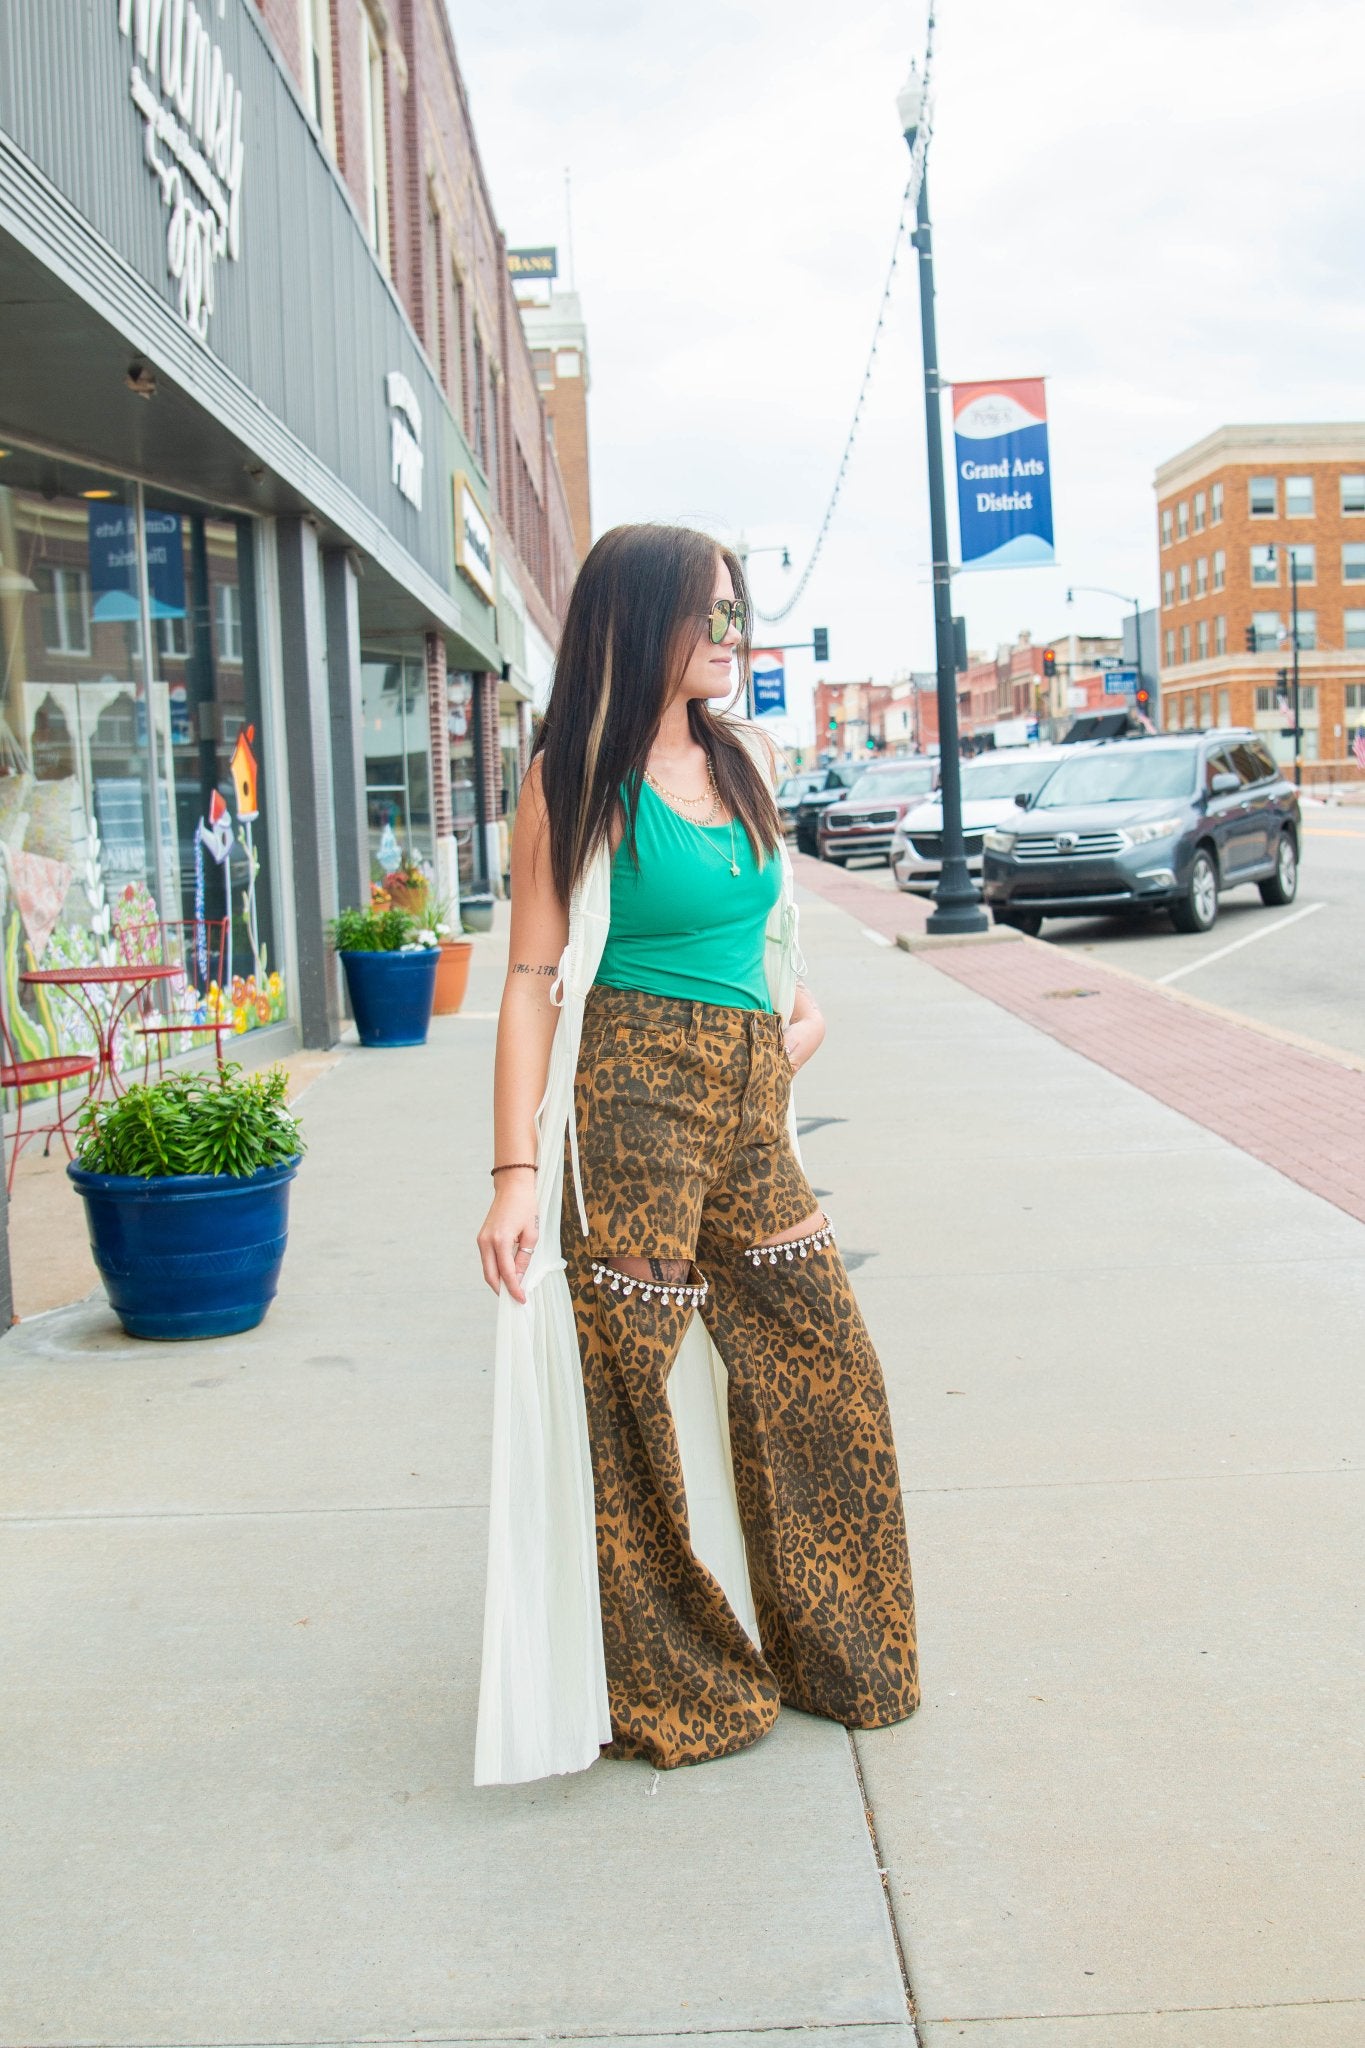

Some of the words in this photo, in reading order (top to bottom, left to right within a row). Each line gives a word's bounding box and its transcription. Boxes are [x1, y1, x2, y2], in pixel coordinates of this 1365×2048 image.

[961, 458, 1009, 480] Grand
[1012, 457, 1045, 477] Arts
[976, 491, 1033, 513] District
